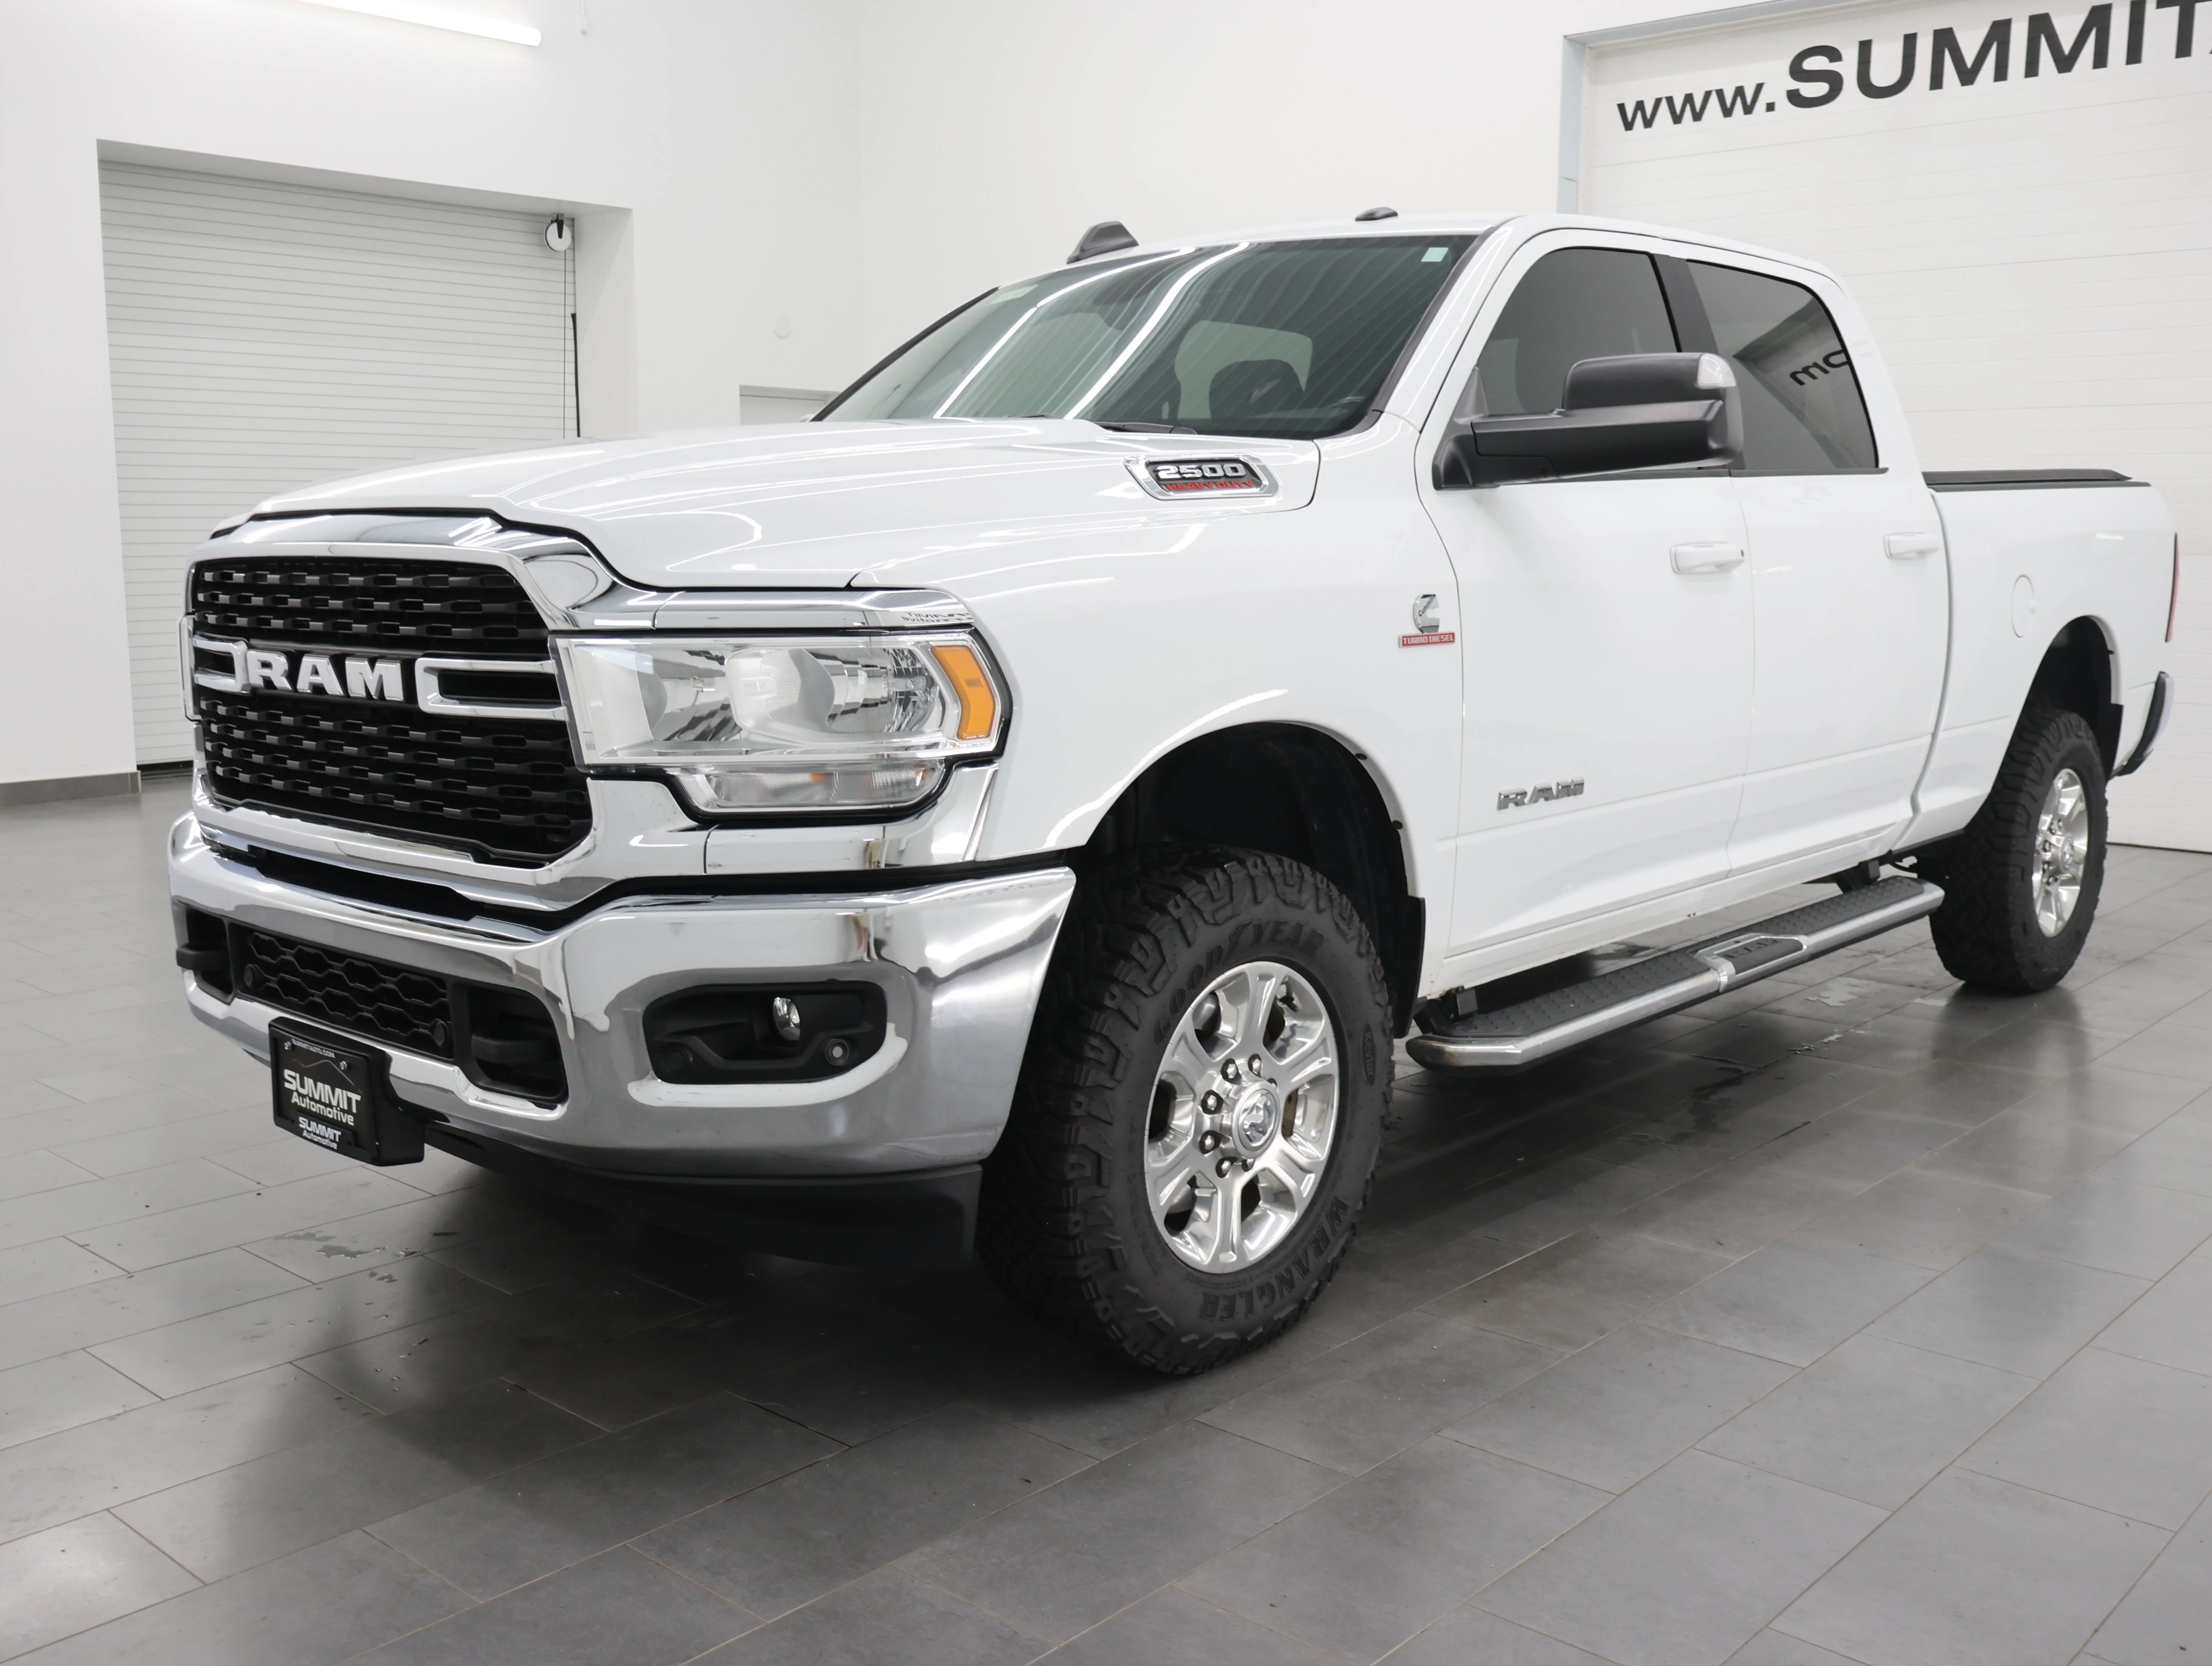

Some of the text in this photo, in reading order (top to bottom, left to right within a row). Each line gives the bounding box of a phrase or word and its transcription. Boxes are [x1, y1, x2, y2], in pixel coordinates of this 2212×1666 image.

[1616, 0, 2212, 131] www.SUMMIT
[1156, 463, 1246, 479] 2500
[1164, 481, 1254, 491] HEAVY DUTY
[1402, 634, 1454, 644] TURBO DIESEL
[246, 650, 404, 701] RAM
[1496, 776, 1584, 811] RAM
[1363, 1030, 1374, 1076] Kevlar
[283, 1069, 361, 1113] SUMMIT
[291, 1094, 354, 1126] Automotive
[298, 1116, 342, 1142] SUMMIT
[302, 1130, 337, 1150] Automotive
[1199, 1196, 1350, 1321] WRANGLER
